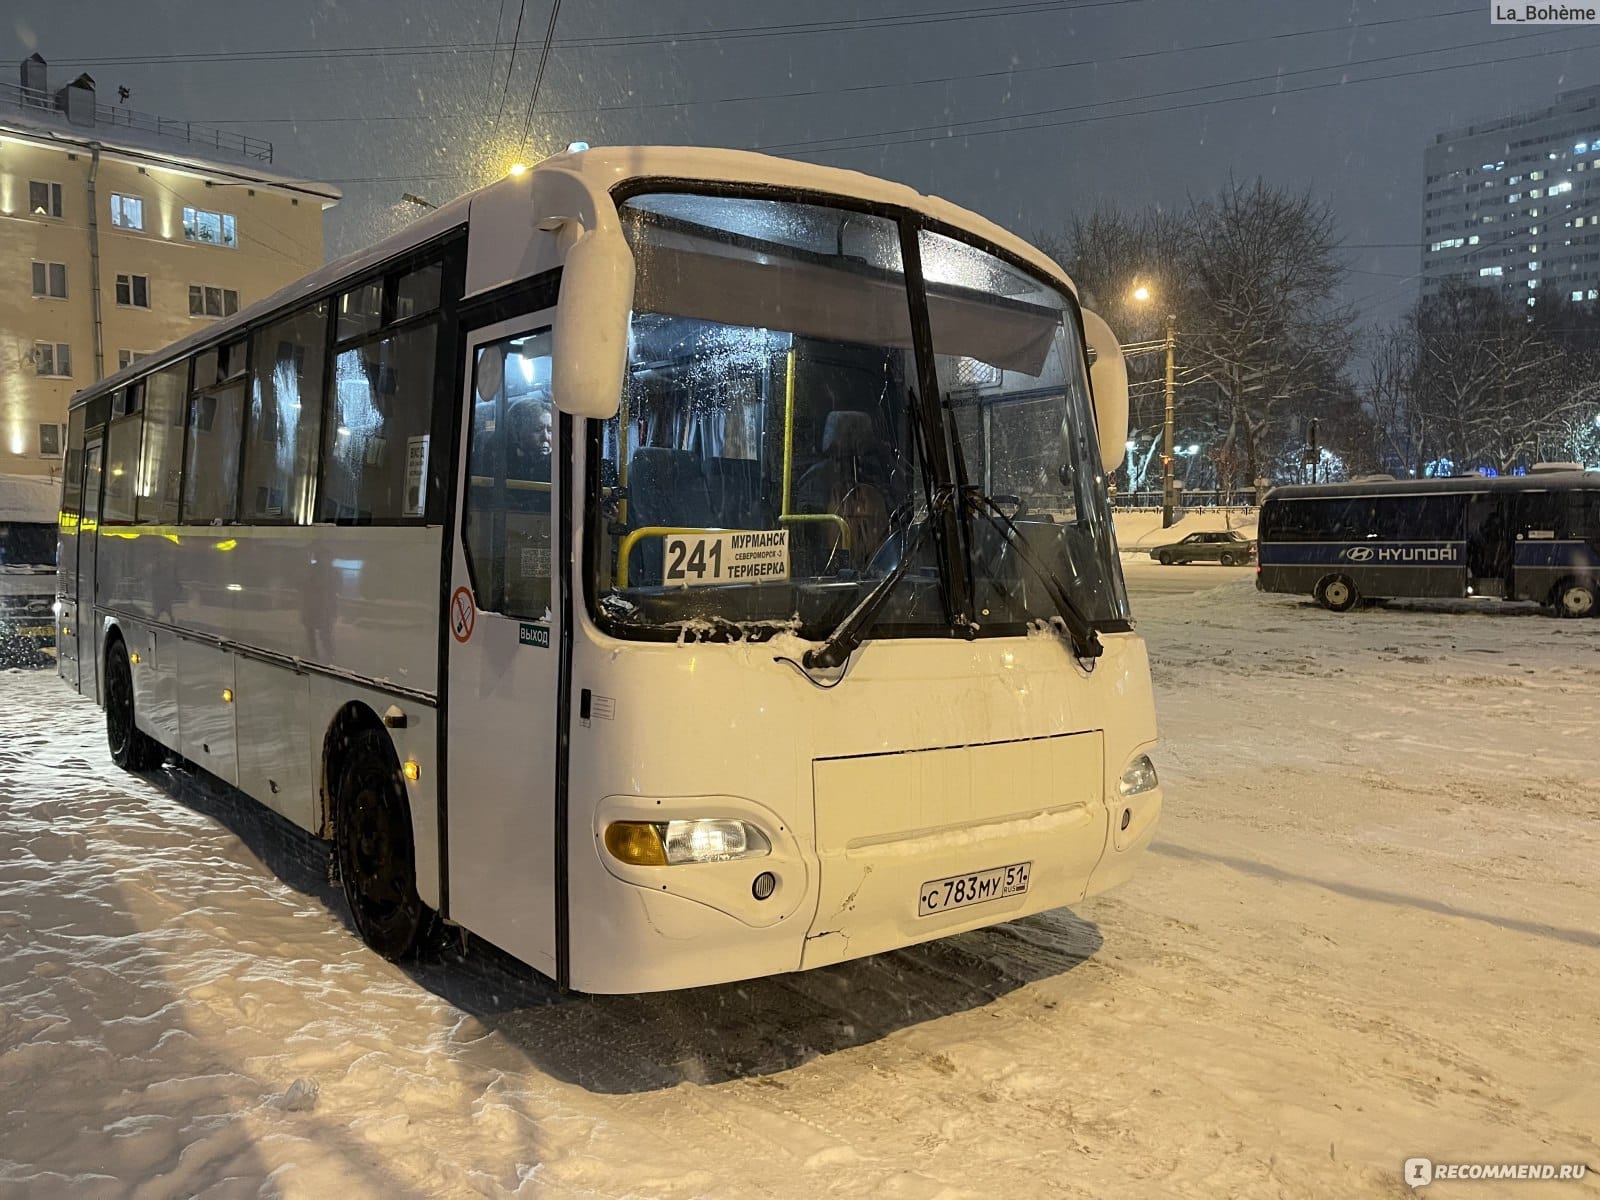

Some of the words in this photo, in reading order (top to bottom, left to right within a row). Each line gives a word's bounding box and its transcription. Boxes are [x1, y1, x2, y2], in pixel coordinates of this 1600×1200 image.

[731, 532, 786, 549] МУРМАНСК
[667, 539, 722, 580] 241
[1378, 548, 1457, 561] HYUNDAI
[728, 561, 785, 578] ТЕРИБЕРКА
[520, 627, 548, 646] ВЫХОД
[1006, 866, 1024, 886] 51
